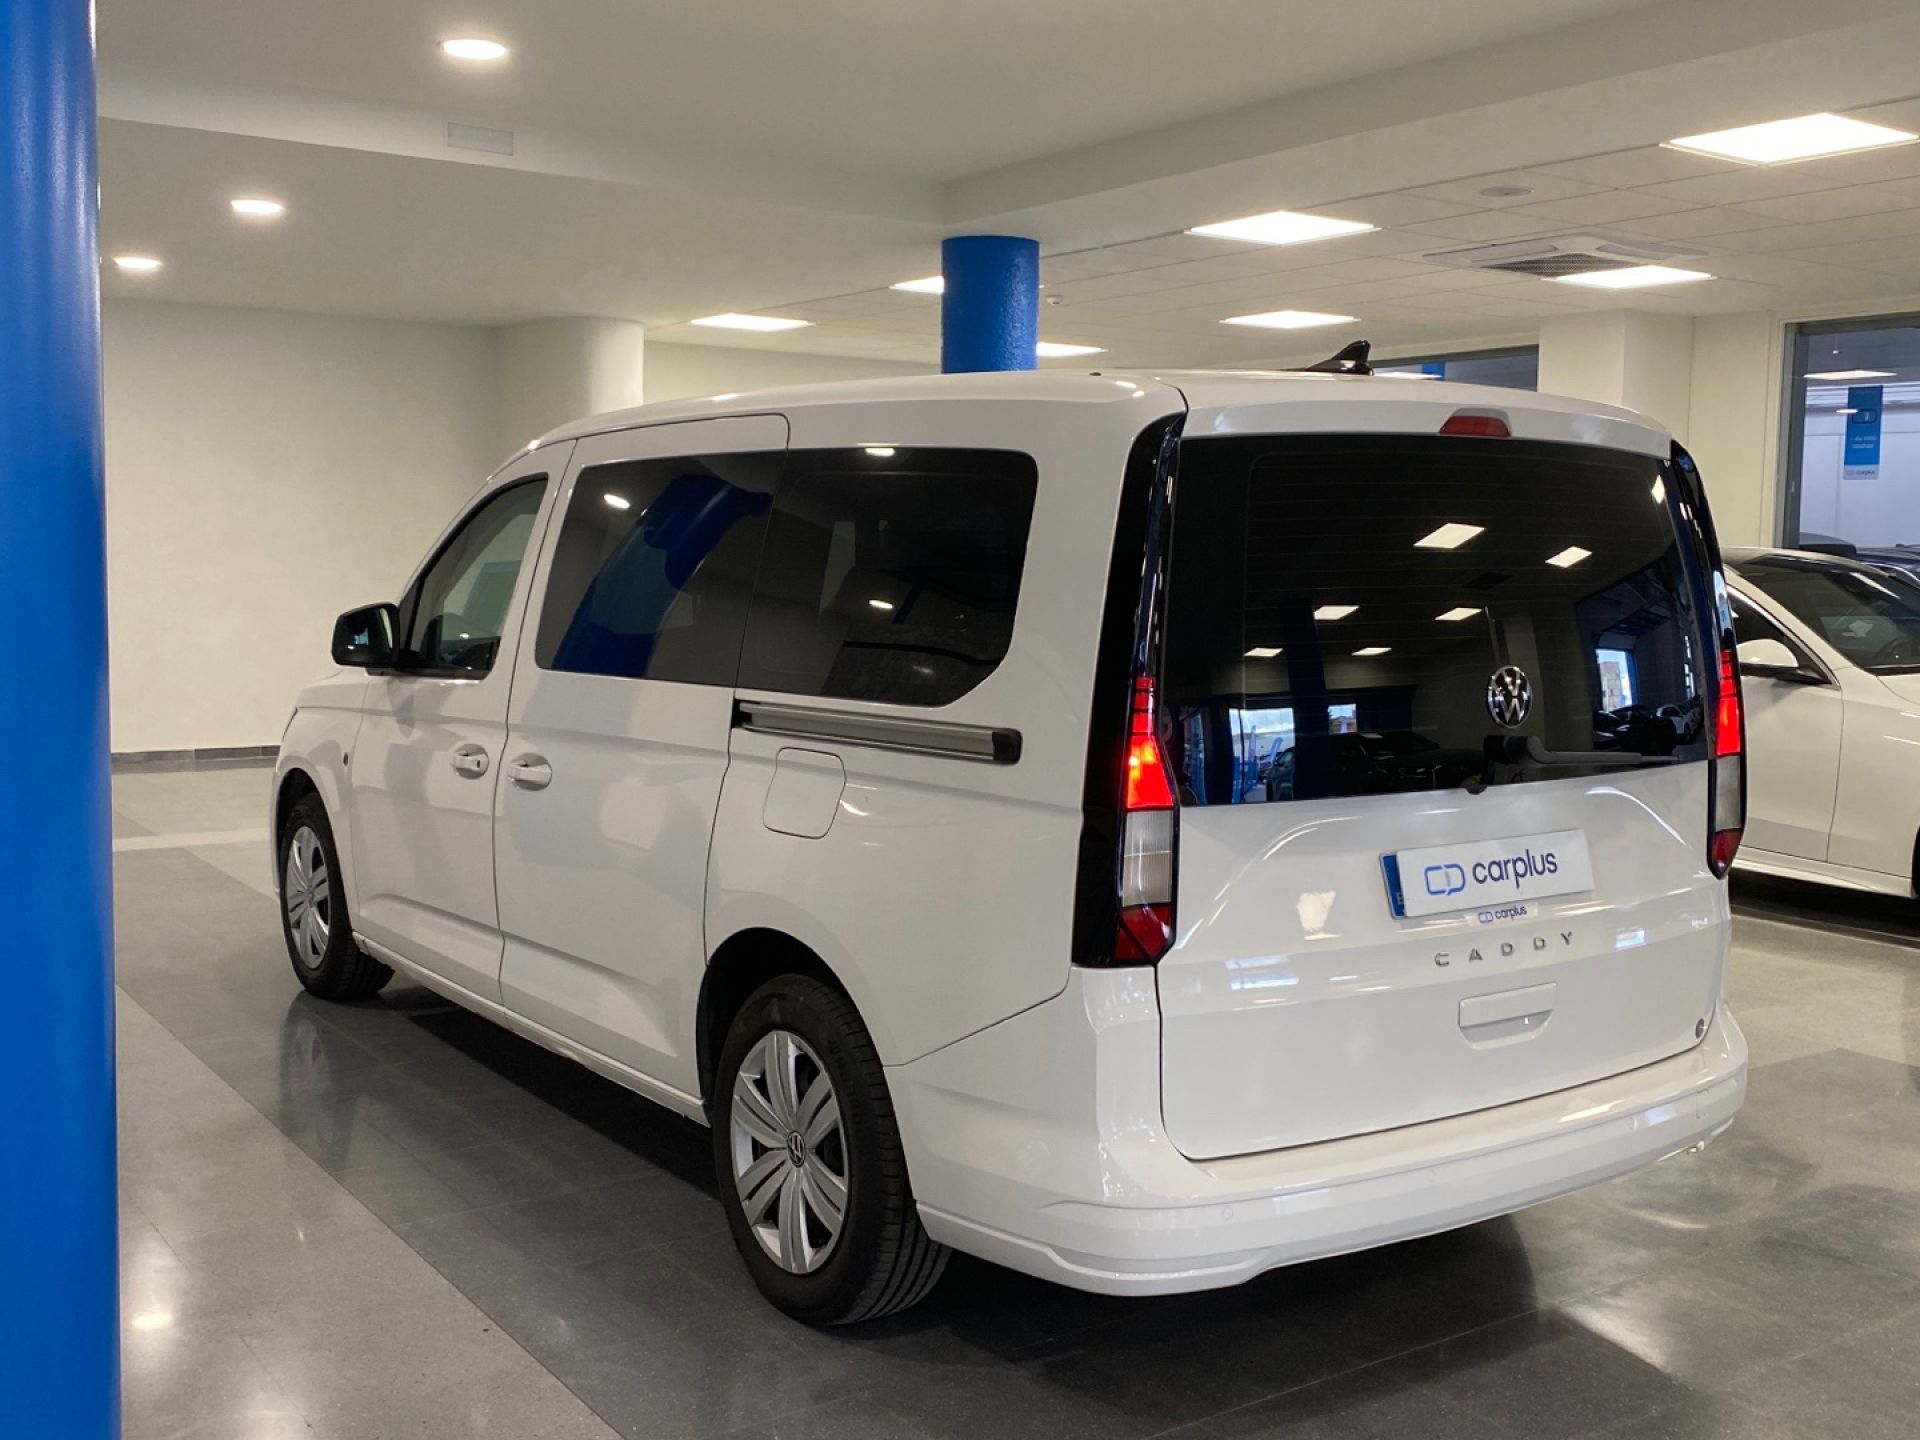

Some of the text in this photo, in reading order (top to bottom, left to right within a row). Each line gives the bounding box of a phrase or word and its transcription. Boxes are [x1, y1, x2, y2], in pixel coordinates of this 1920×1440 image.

[1472, 849, 1558, 889] carplus
[1495, 905, 1528, 920] carplus
[1434, 931, 1573, 967] CADDY
